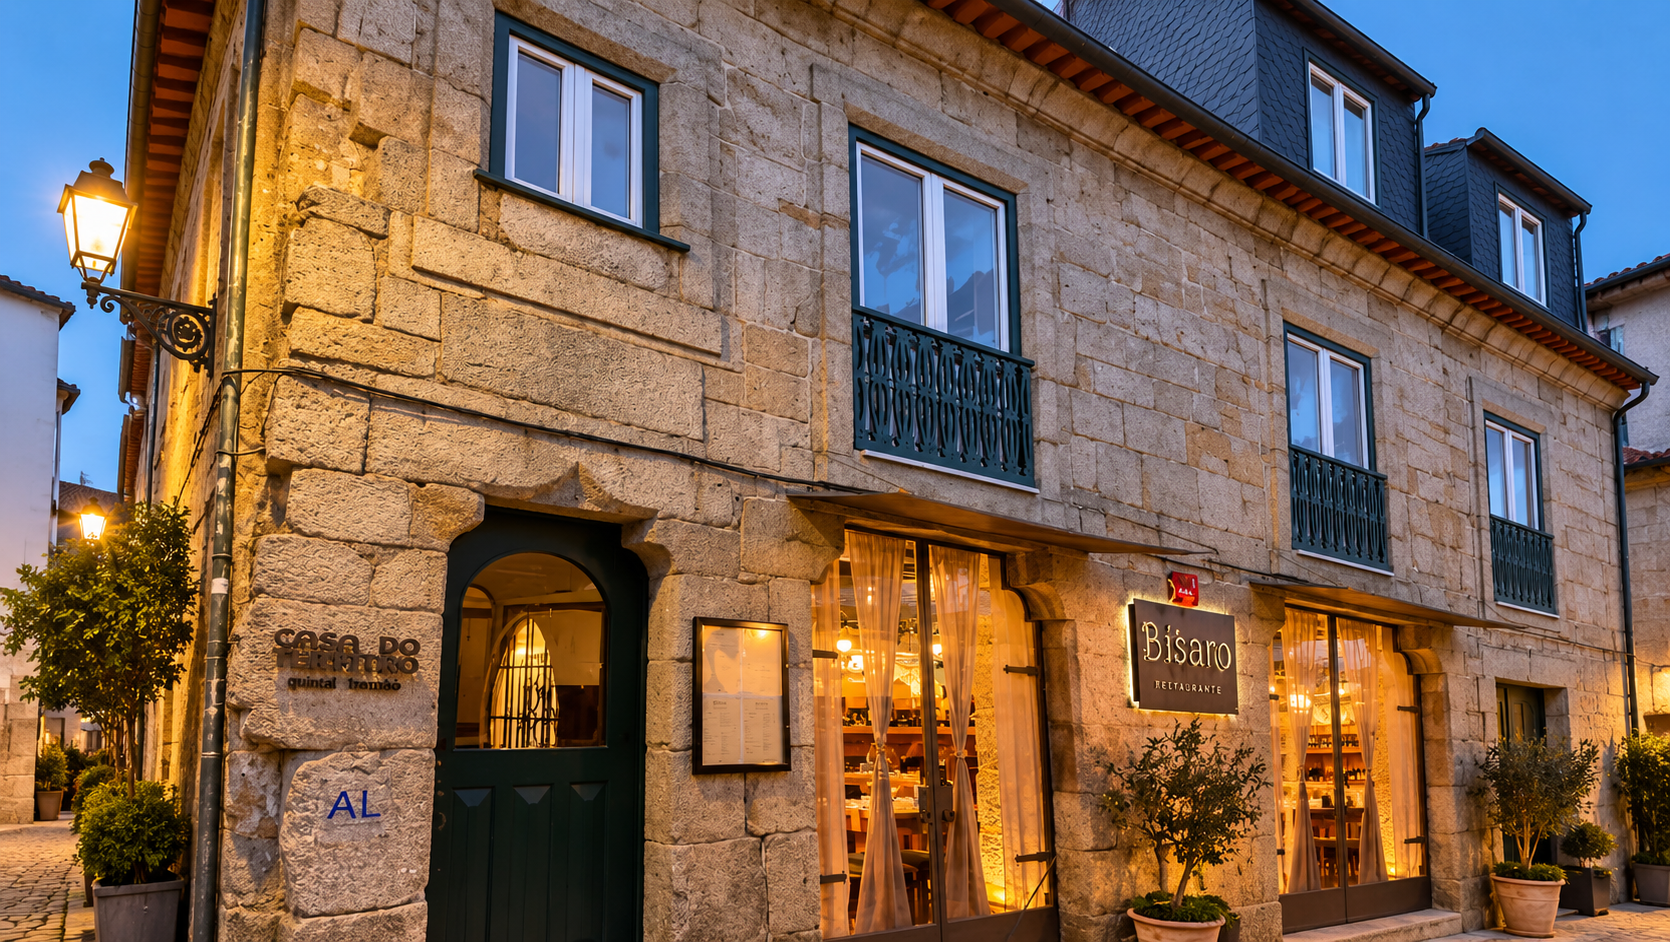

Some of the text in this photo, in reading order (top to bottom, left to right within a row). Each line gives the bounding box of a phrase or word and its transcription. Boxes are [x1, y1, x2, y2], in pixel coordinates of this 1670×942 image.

[274, 628, 421, 656] CASA DO
[287, 676, 337, 691] quintal
[327, 790, 381, 819] AL
